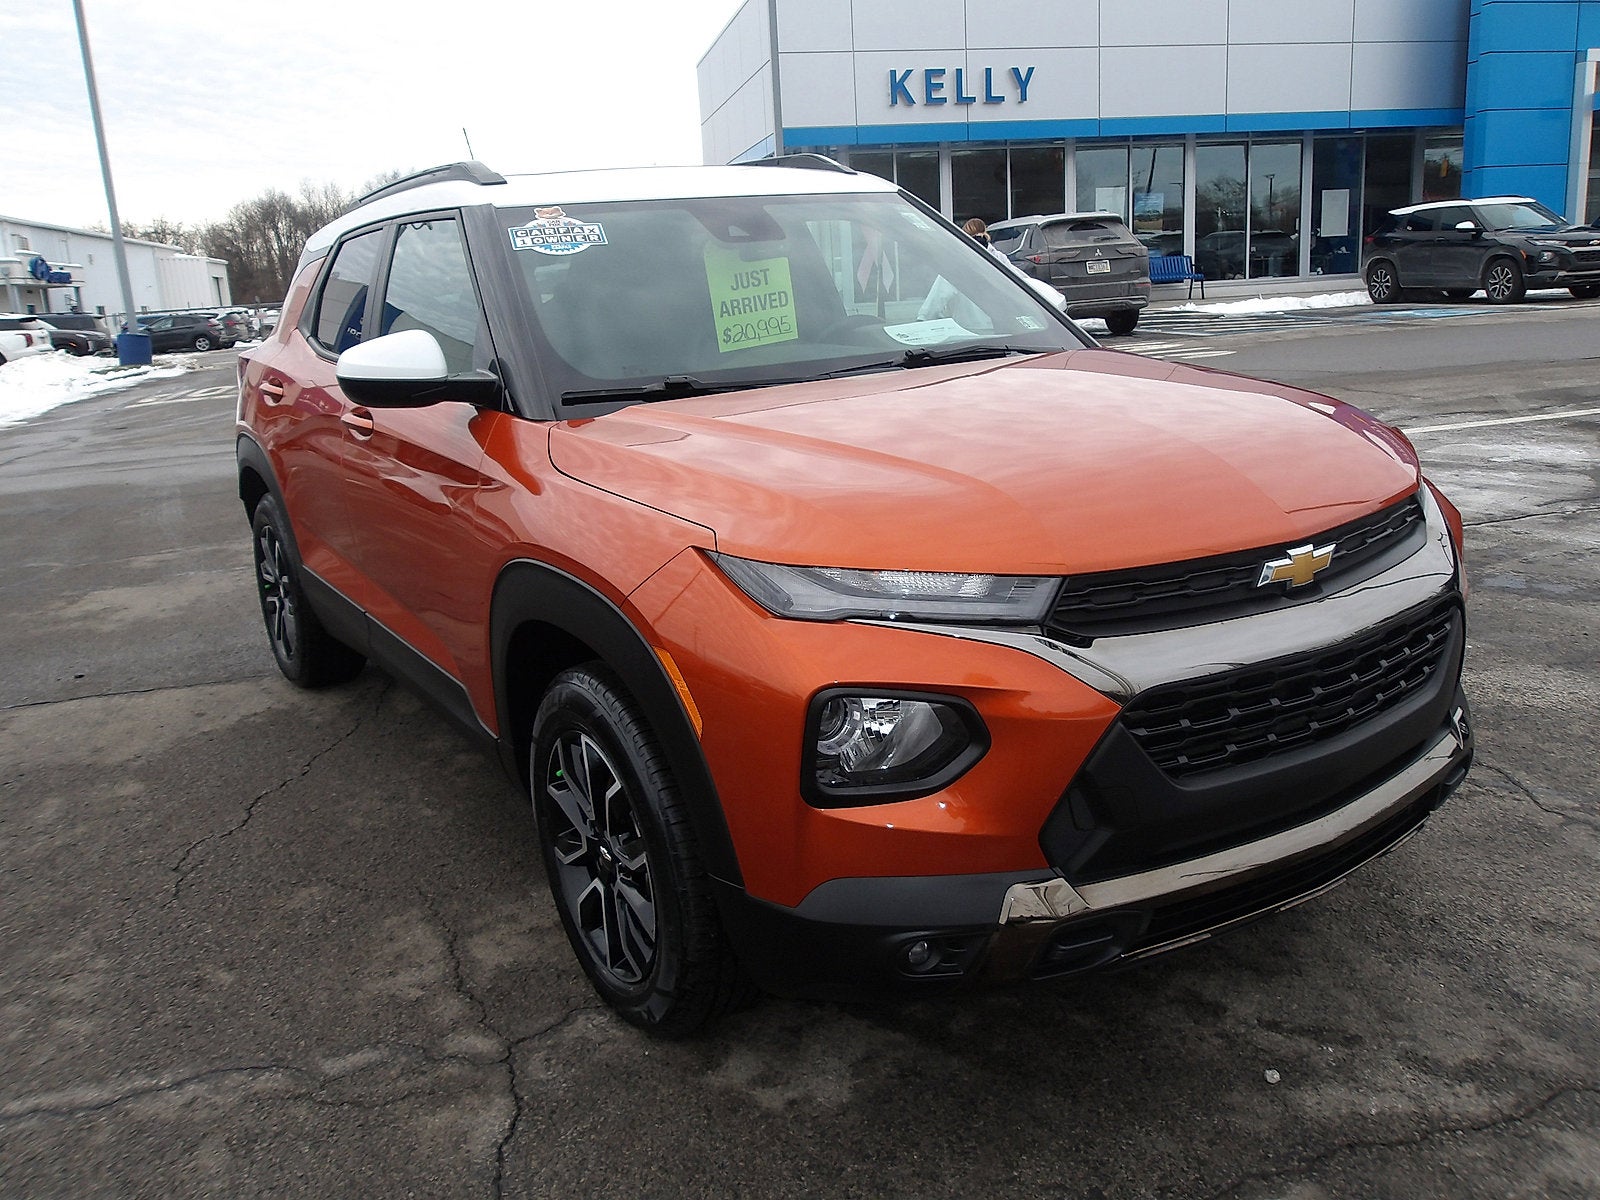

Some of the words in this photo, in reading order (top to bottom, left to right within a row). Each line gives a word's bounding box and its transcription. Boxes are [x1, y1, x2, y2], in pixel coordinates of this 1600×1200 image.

[889, 66, 1035, 106] KELLY
[515, 227, 597, 237] CARFAX
[730, 268, 770, 291] JUST
[720, 290, 789, 318] ARRIVED
